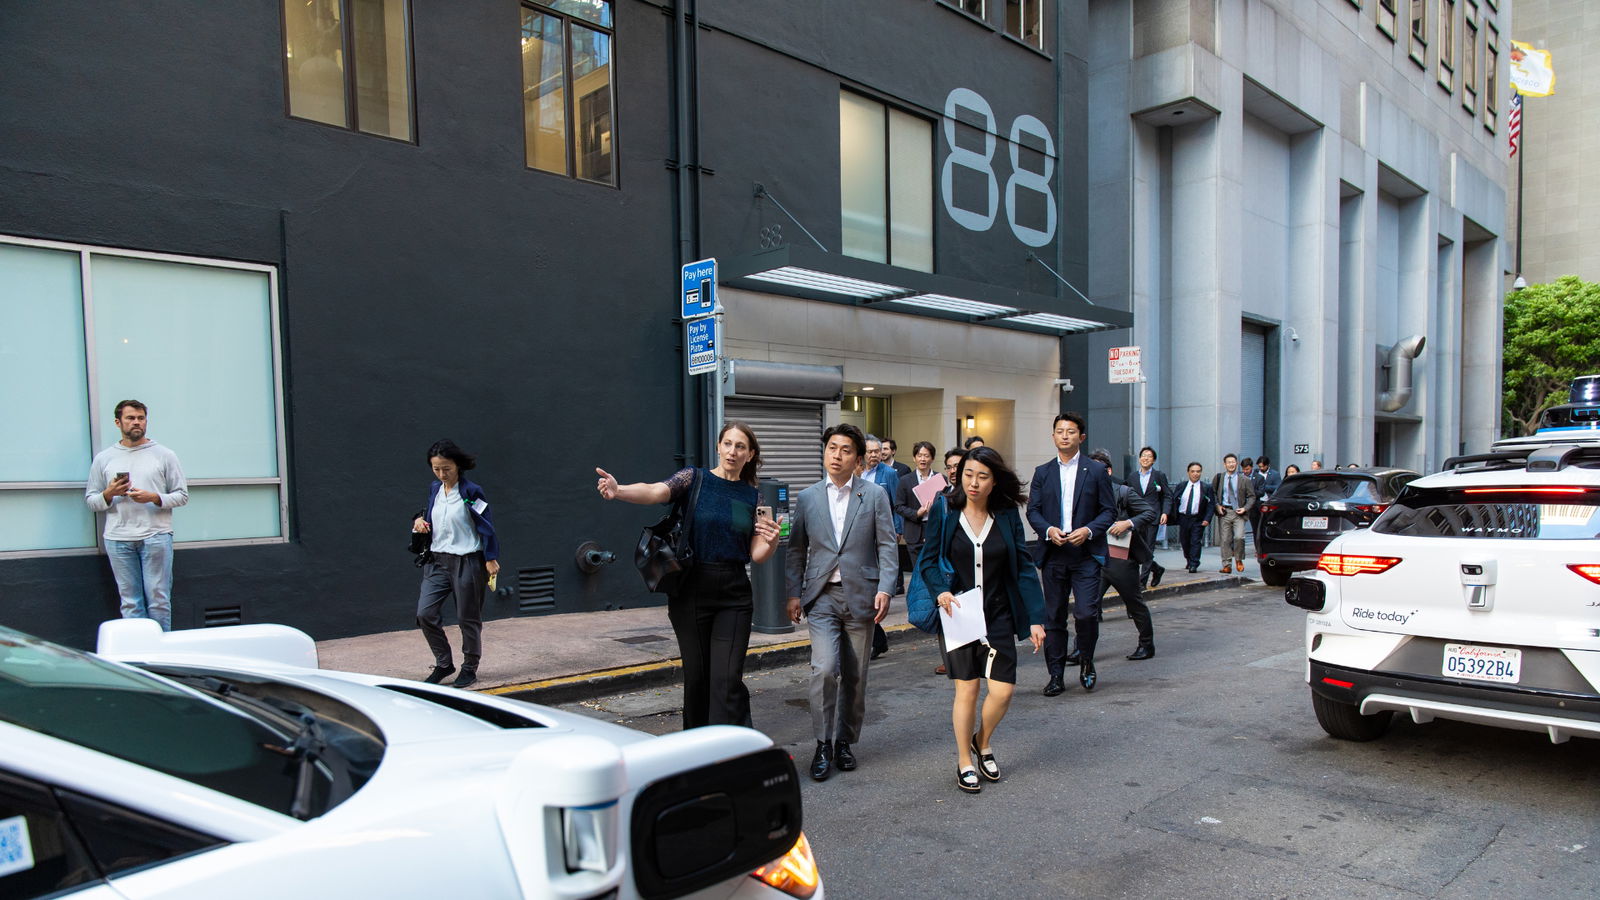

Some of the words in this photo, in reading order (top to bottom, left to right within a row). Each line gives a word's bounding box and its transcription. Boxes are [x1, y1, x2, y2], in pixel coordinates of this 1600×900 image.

[942, 87, 1058, 248] 88
[760, 224, 782, 249] 88
[685, 271, 696, 281] Pay
[697, 267, 713, 277] here
[690, 325, 699, 335] Pay
[700, 323, 707, 333] by
[690, 334, 708, 343] License
[691, 345, 704, 354] Plate
[1295, 445, 1309, 454] 575
[1352, 607, 1375, 619] Ride
[1377, 610, 1409, 625] today
[1448, 657, 1514, 676] 05392B4
